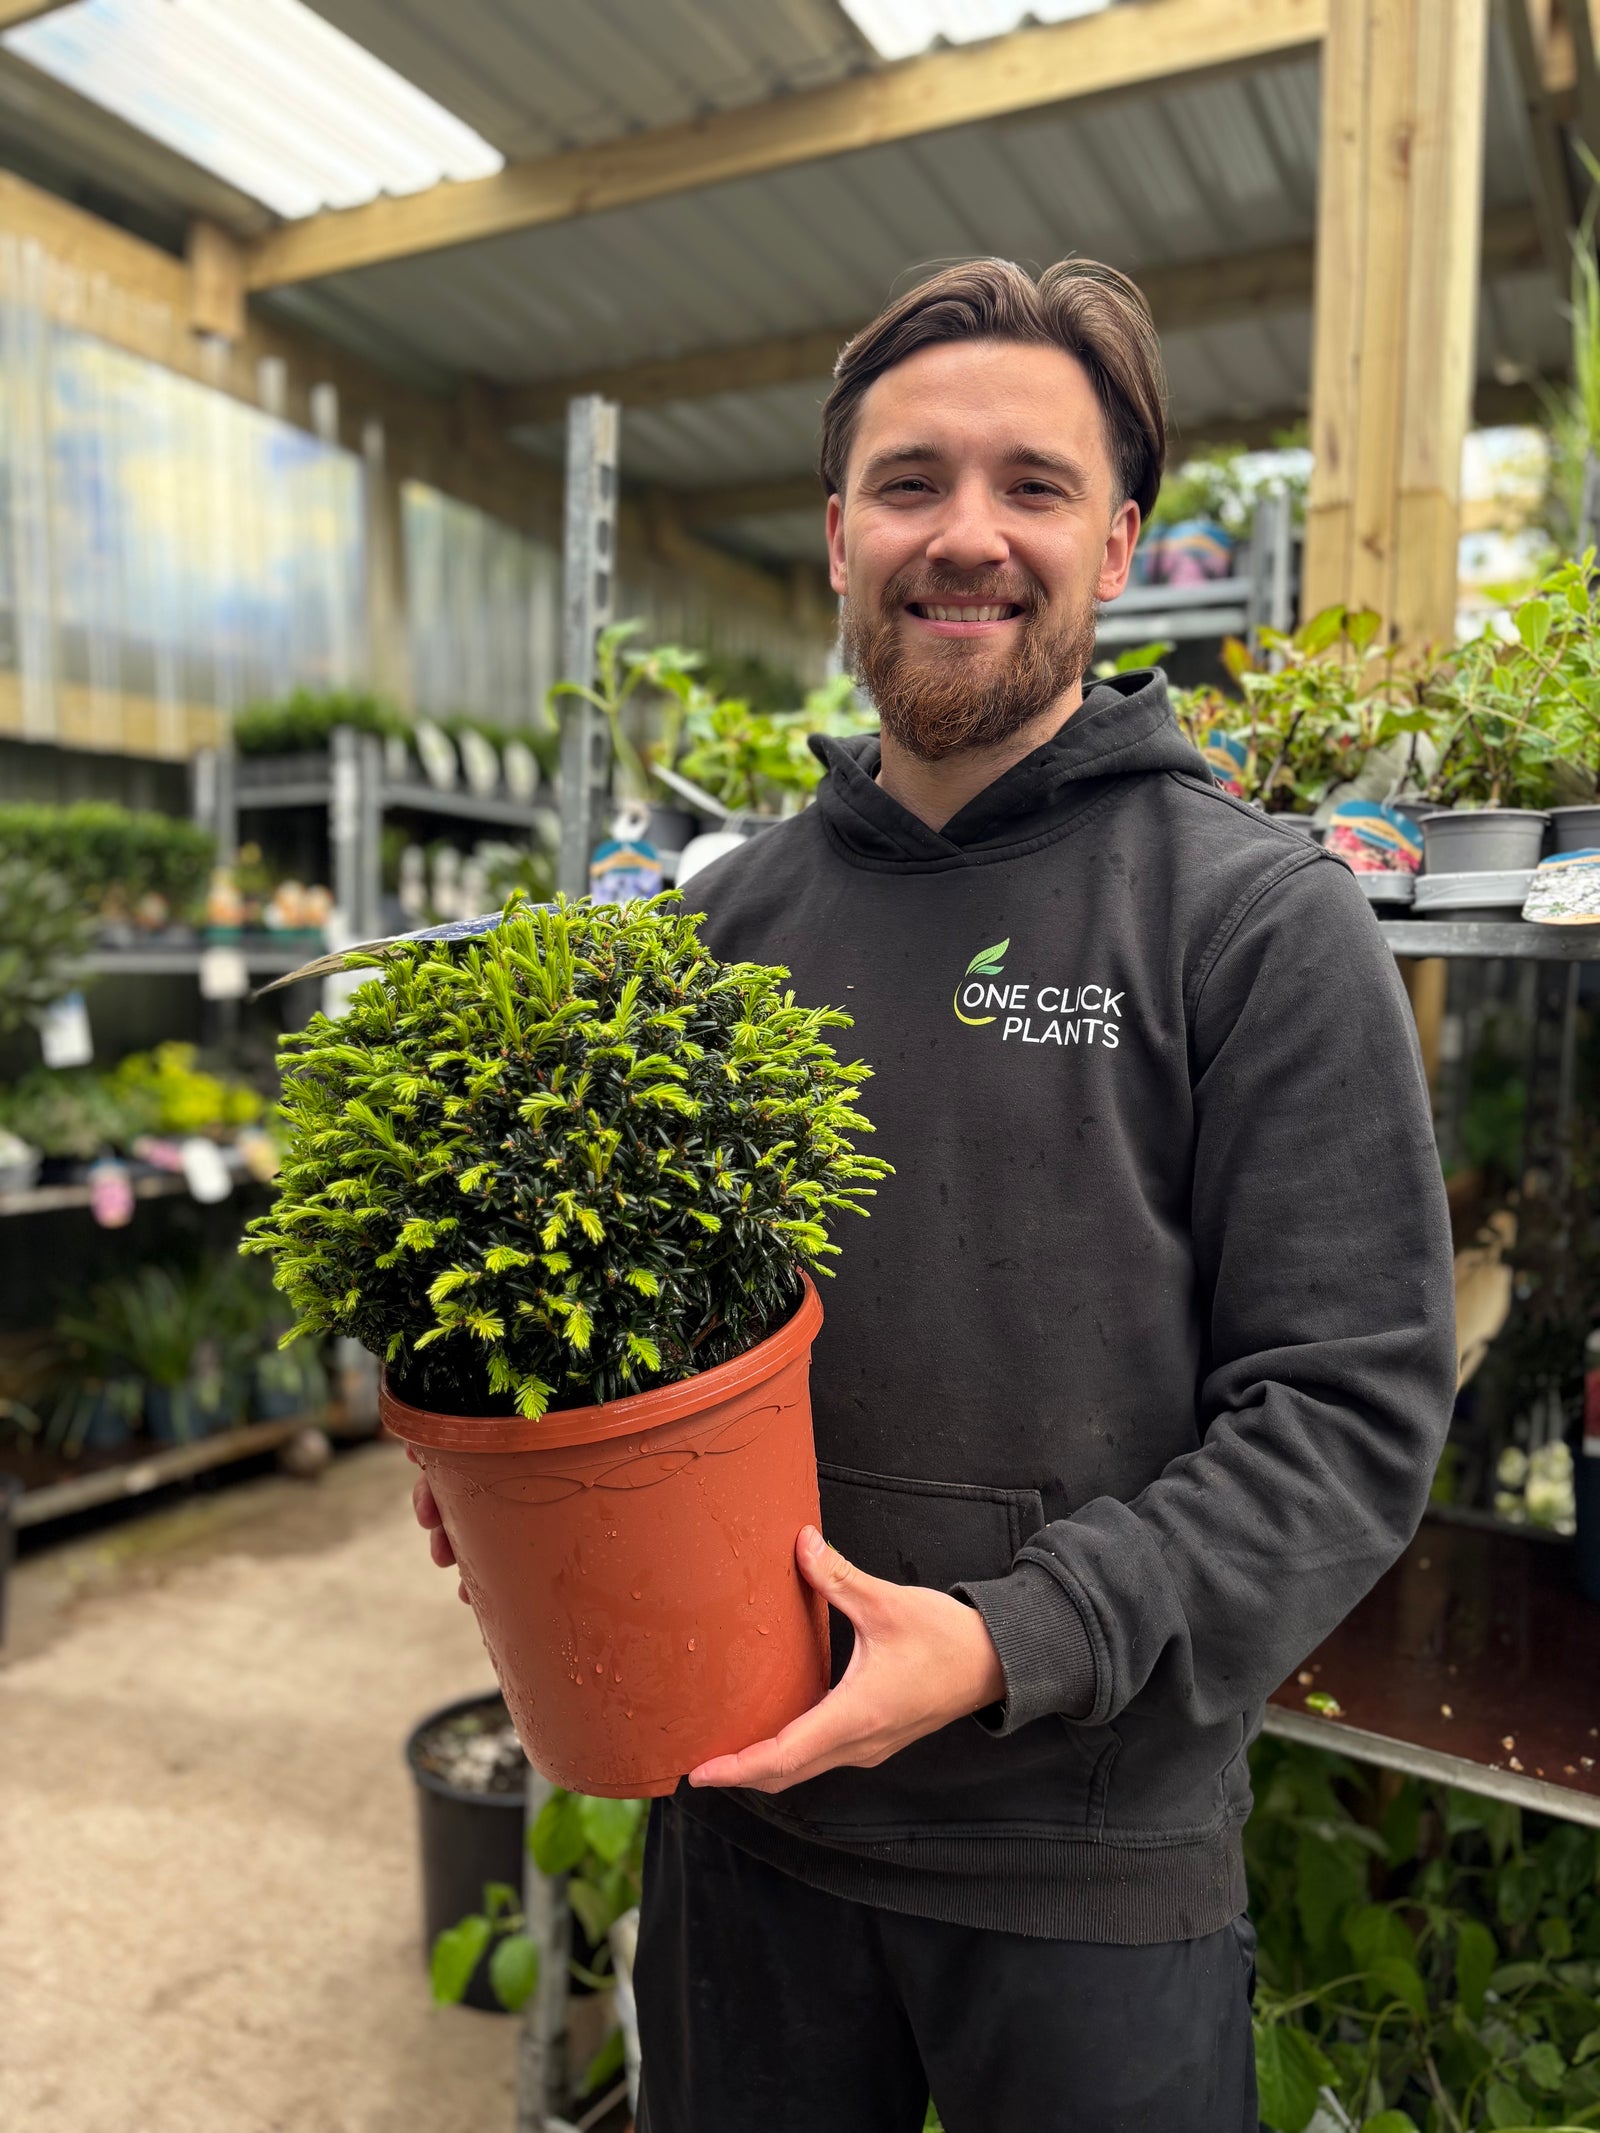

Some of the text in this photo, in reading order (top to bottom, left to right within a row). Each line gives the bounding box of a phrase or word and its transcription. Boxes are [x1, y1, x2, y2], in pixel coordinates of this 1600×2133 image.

[963, 982, 1126, 1018] ONE CLICK
[1002, 1016, 1120, 1049] PLANTS
